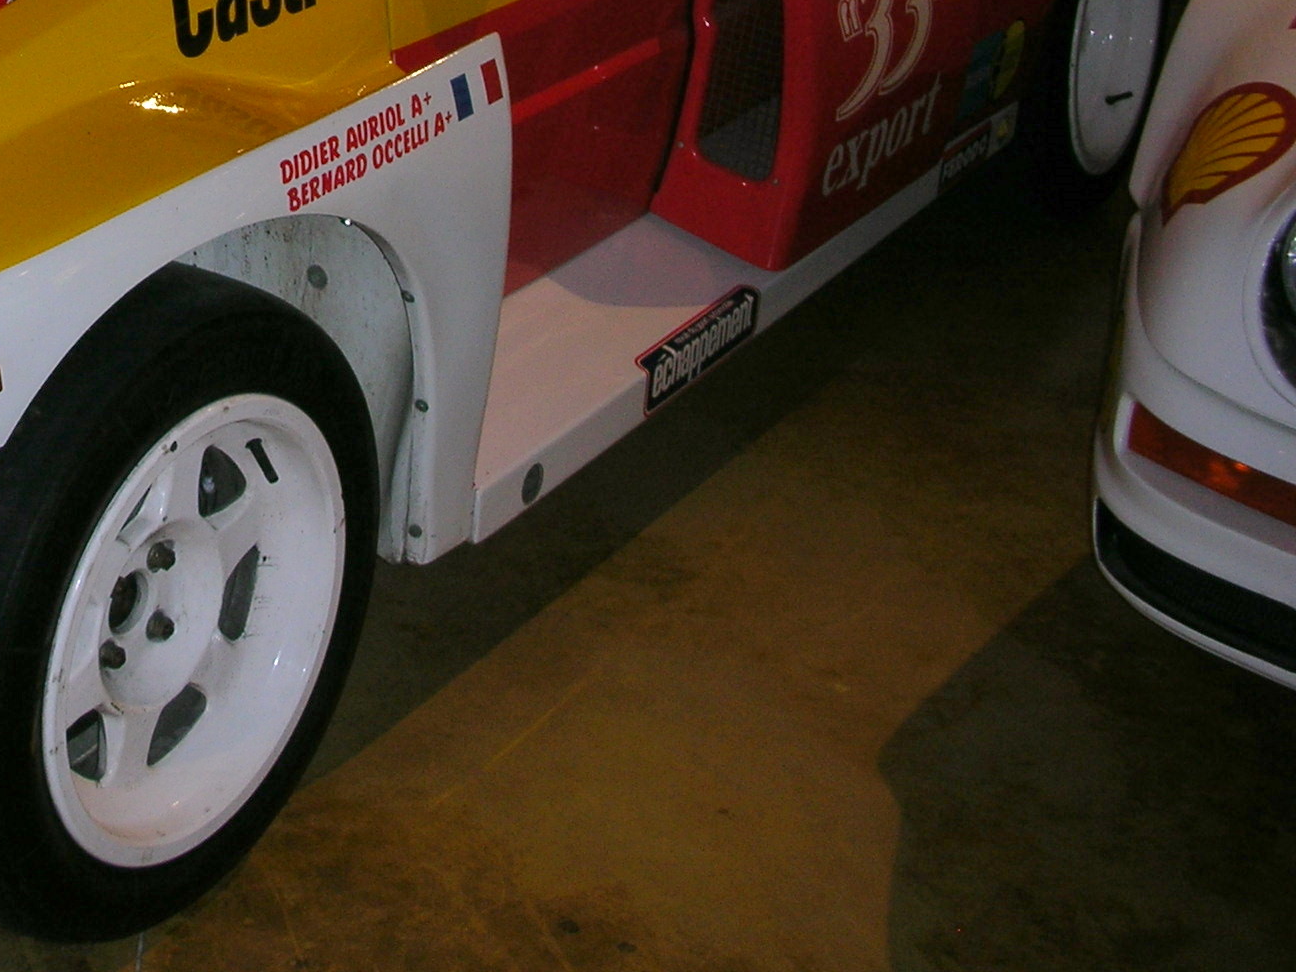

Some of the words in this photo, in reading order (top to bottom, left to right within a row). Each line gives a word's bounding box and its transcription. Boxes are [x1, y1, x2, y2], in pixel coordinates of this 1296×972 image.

[279, 141, 341, 186] DIDIER
[346, 103, 406, 154] AURIOL
[411, 91, 433, 119] A+
[286, 159, 368, 213] BERNARD
[372, 122, 430, 170] OCCELLI
[434, 110, 453, 137] A+
[821, 70, 944, 198] export
